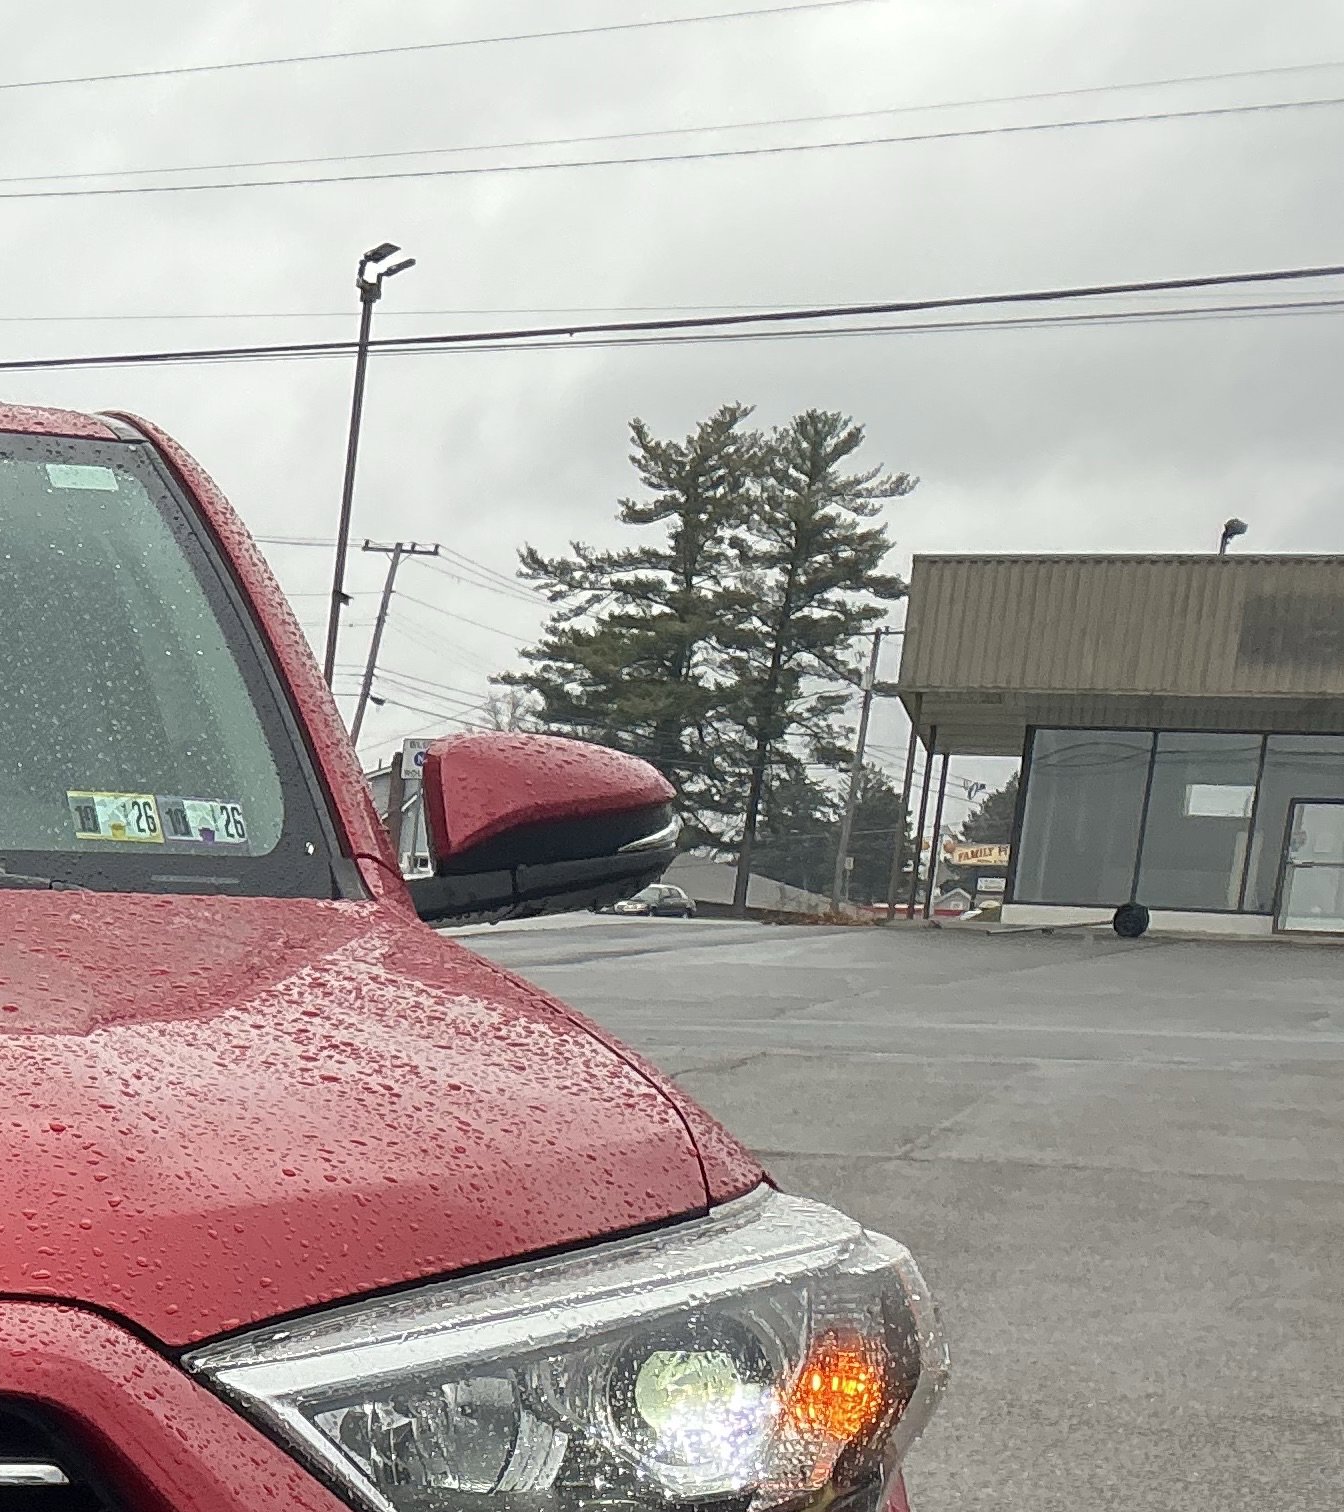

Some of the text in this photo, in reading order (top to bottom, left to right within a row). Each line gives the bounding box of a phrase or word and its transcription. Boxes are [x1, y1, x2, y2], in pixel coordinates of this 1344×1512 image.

[132, 801, 157, 833] 26
[220, 806, 245, 839] 26
[958, 846, 994, 862] FAMILY
